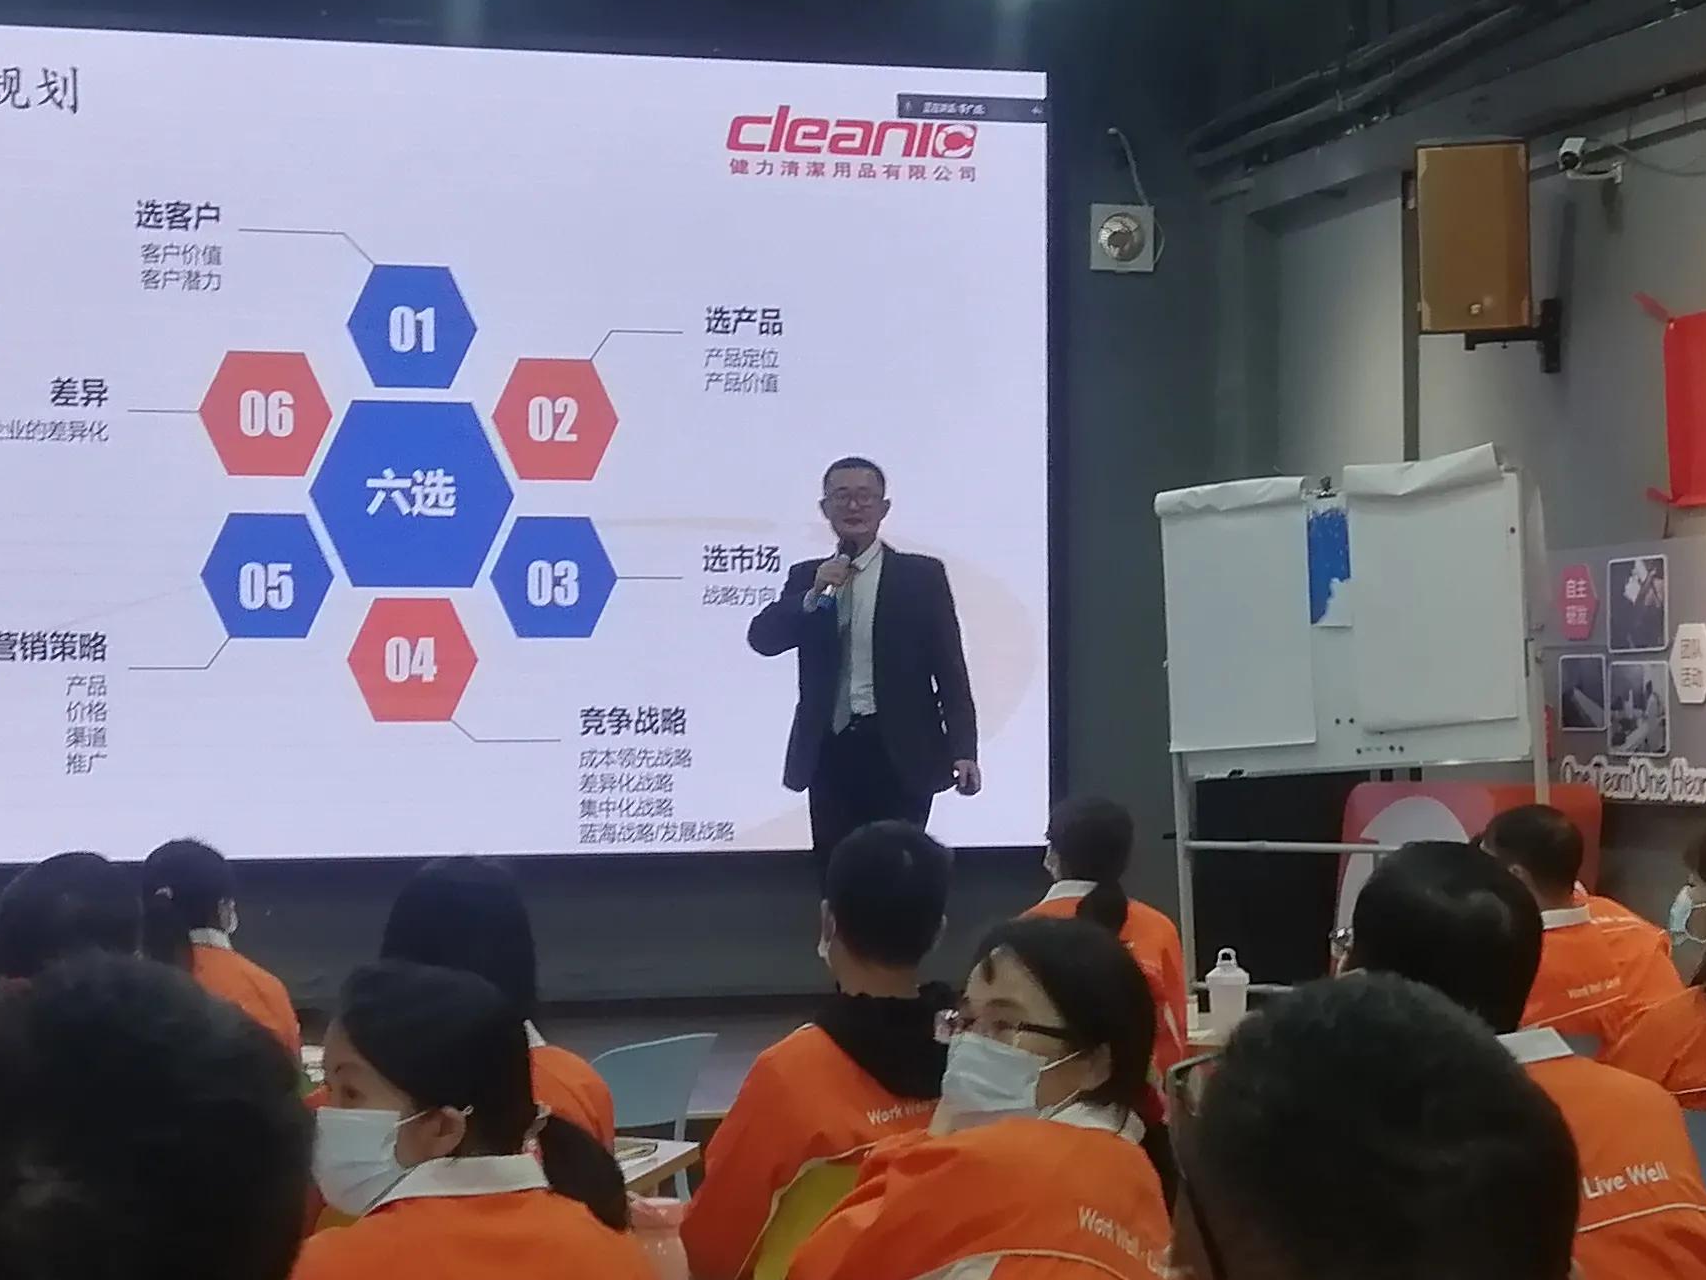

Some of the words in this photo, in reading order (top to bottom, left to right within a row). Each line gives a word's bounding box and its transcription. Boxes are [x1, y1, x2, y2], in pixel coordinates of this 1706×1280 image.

[726, 105, 979, 159] cleanic
[134, 198, 222, 232] 选客户
[139, 243, 223, 267] 客户价值
[139, 269, 223, 293] 客户潜力
[389, 304, 437, 354] 01
[704, 305, 784, 337] 选产品
[703, 346, 780, 370] 产品定位
[48, 376, 110, 409] 差异
[703, 371, 780, 395] 产品价值
[238, 389, 295, 438] 06
[527, 395, 579, 443] 02
[365, 467, 457, 518] 六选
[702, 543, 782, 575] 选市场
[238, 561, 295, 611] 05
[526, 559, 580, 608] 03
[701, 585, 778, 606] 战略方向
[383, 636, 438, 684] 04
[65, 674, 108, 697] 产品
[65, 700, 108, 723] 价格
[578, 706, 687, 737] 竞争战略
[65, 726, 108, 749] 渠道
[65, 752, 108, 775] 推广
[578, 747, 693, 769] 成本领先战略
[578, 772, 674, 794] 差异化战略
[578, 796, 674, 819] 集中化战略
[578, 820, 735, 844] 蓝海战略/发展战略
[866, 1103, 902, 1126] Work
[1582, 1175, 1628, 1200] Live
[1625, 1160, 1670, 1186] Well
